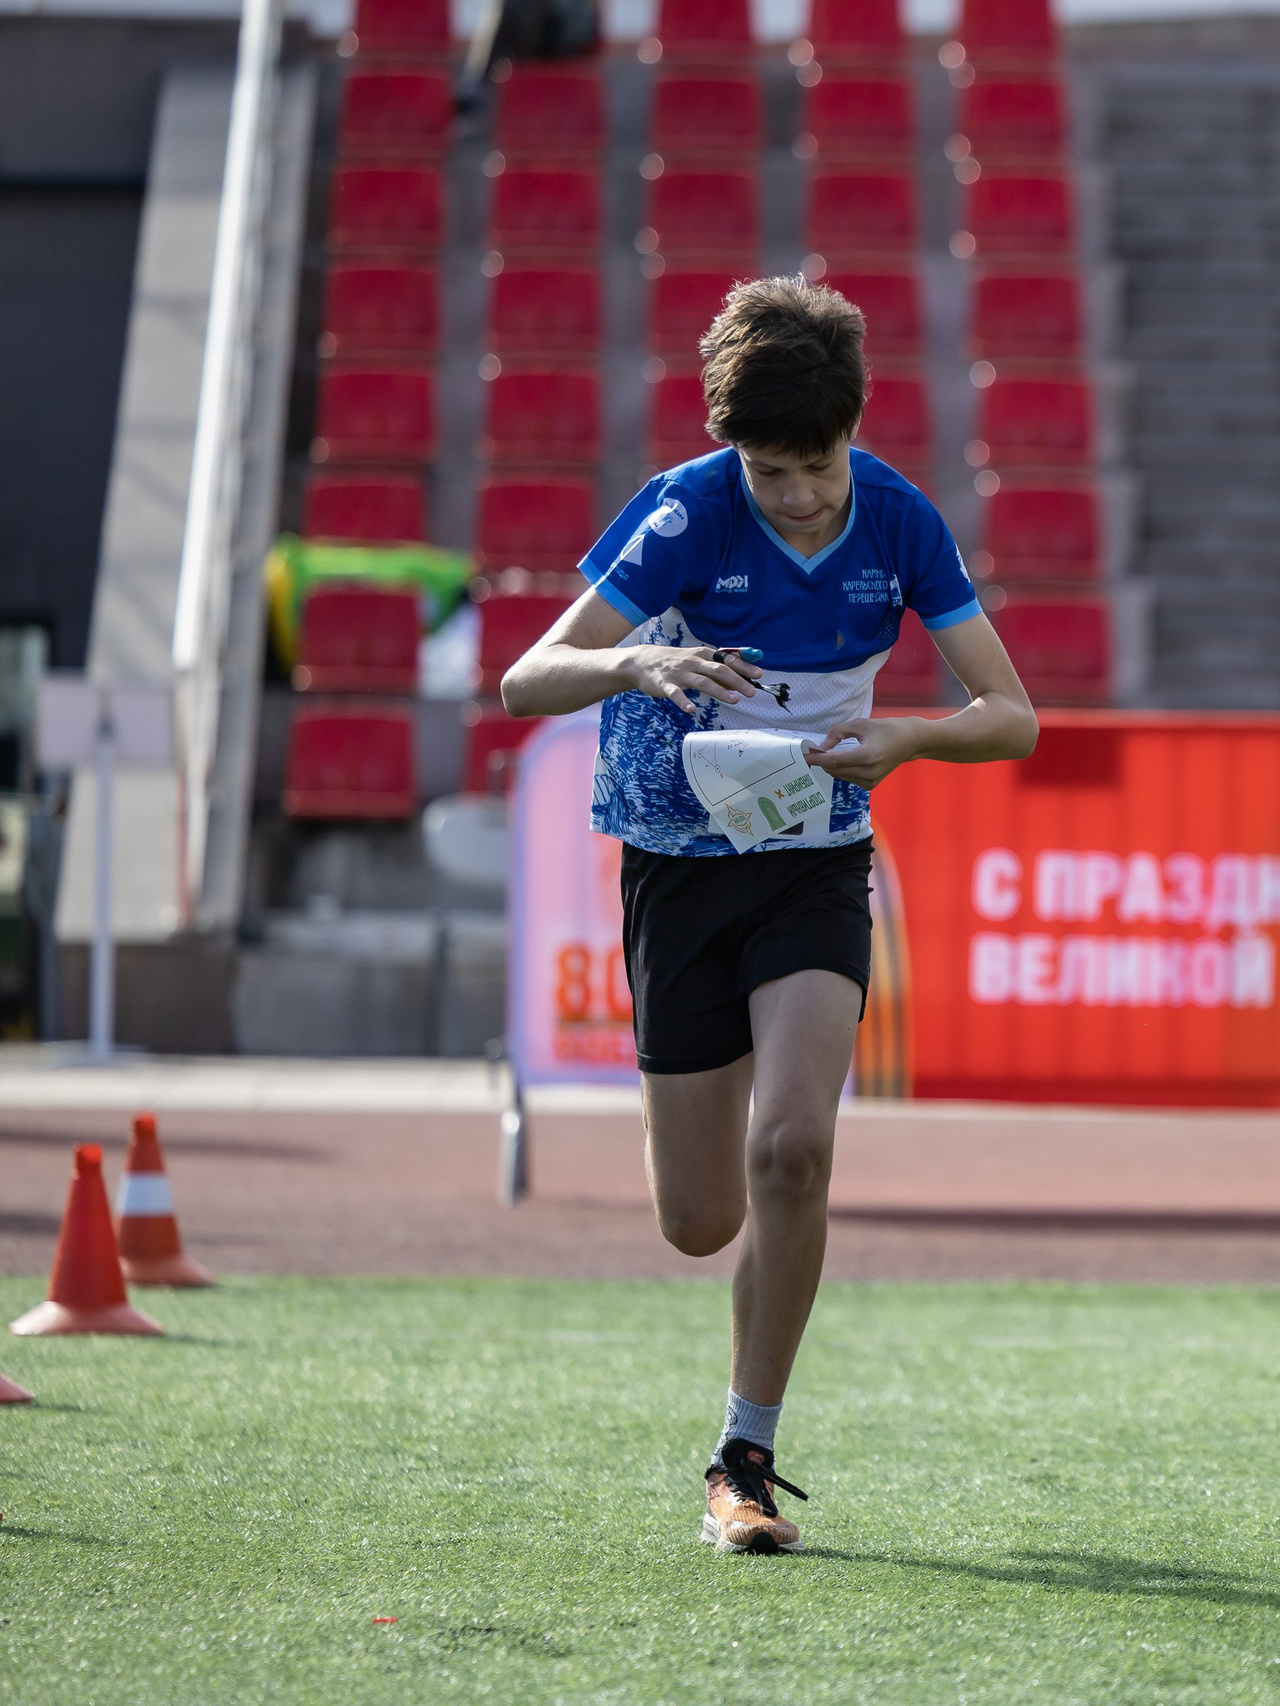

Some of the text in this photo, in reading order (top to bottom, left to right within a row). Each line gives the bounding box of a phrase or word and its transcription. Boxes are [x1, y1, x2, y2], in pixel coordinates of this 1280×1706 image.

[842, 580, 888, 591] КАРЕЛЬСКОГО
[848, 592, 890, 603] ПЕРЕШЕЙКА
[782, 773, 815, 797] ЛАБИРИНТ
[786, 791, 826, 819] СПОРТИВНЫЙ
[972, 849, 1021, 921] С
[970, 928, 1275, 1008] ВЕЛИКОЙ
